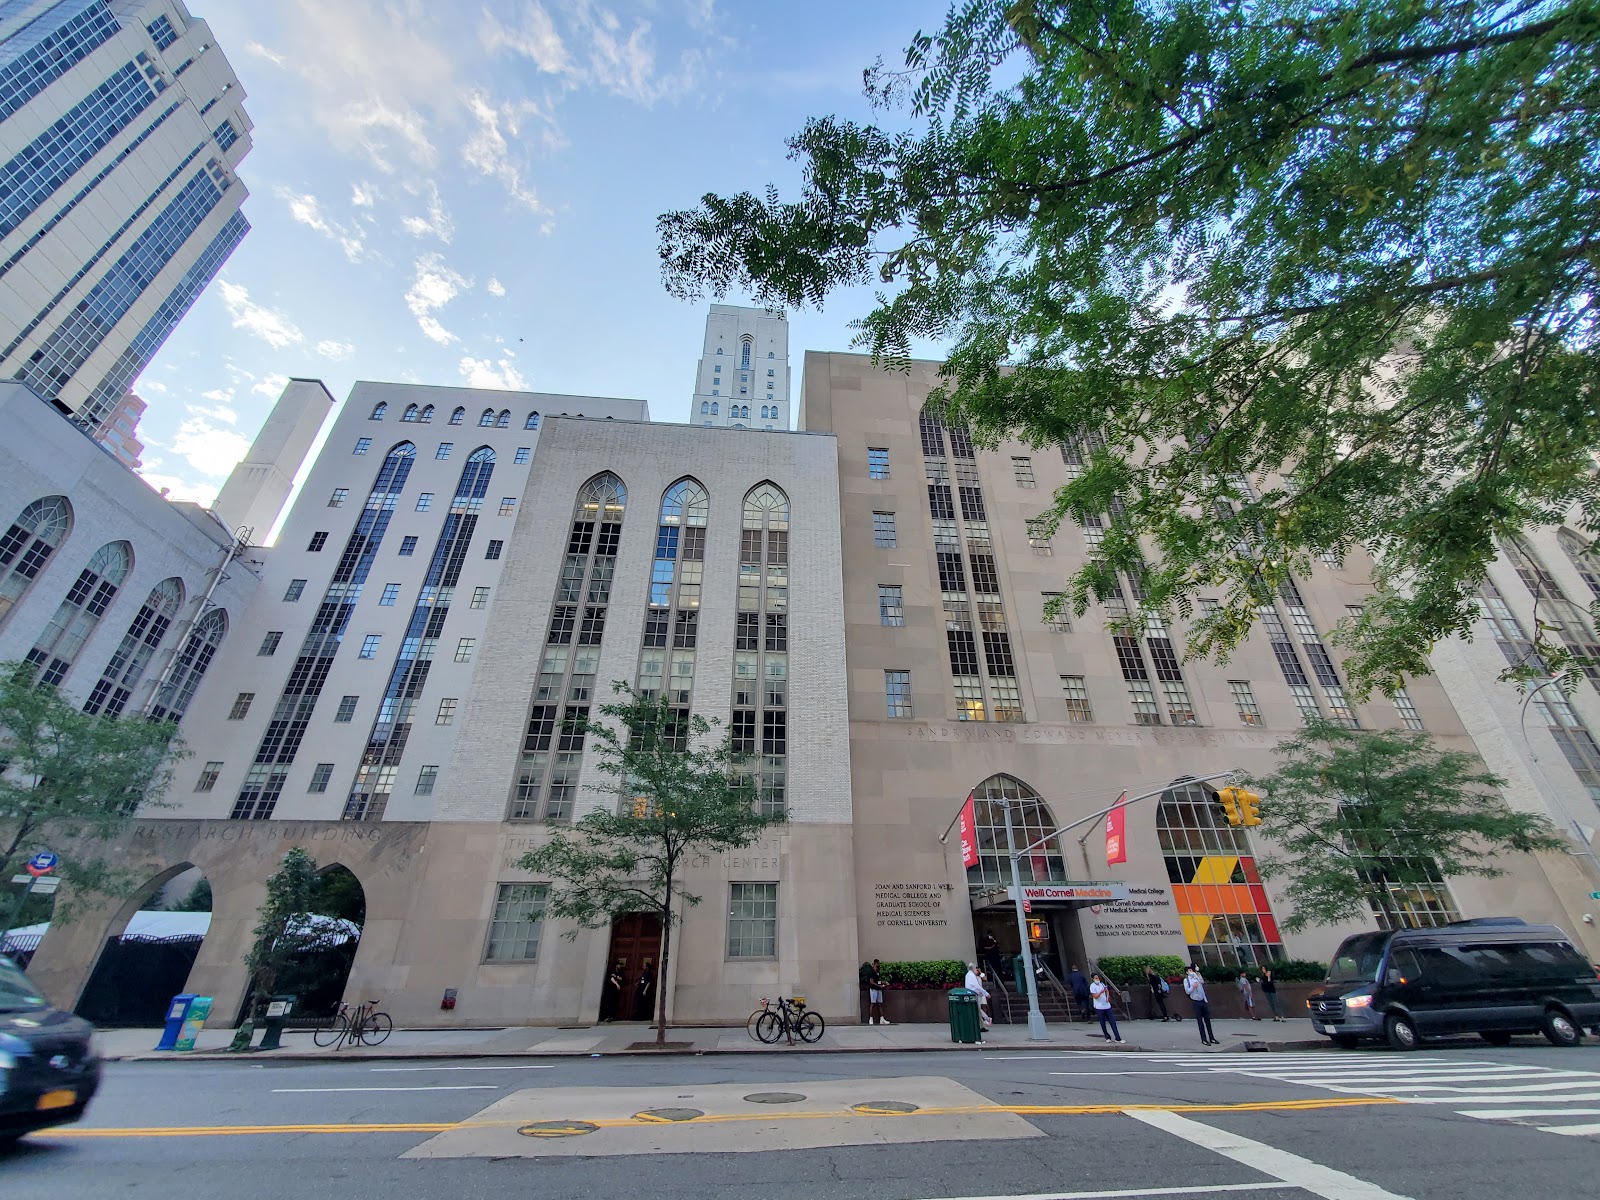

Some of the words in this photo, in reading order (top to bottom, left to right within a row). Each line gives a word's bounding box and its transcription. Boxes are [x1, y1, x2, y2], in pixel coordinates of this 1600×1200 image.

[907, 727, 972, 738] SANDRA
[983, 728, 1013, 738] AND
[1024, 730, 1085, 740] EDWARD
[1238, 733, 1265, 743] AND
[134, 825, 254, 840] RESEARCH
[267, 827, 382, 842] BUILDING
[509, 838, 537, 849] THE
[723, 857, 779, 869] CENTER
[1025, 889, 1045, 897] Weill
[1045, 889, 1074, 897] Cornell
[1075, 889, 1112, 897] Medicine
